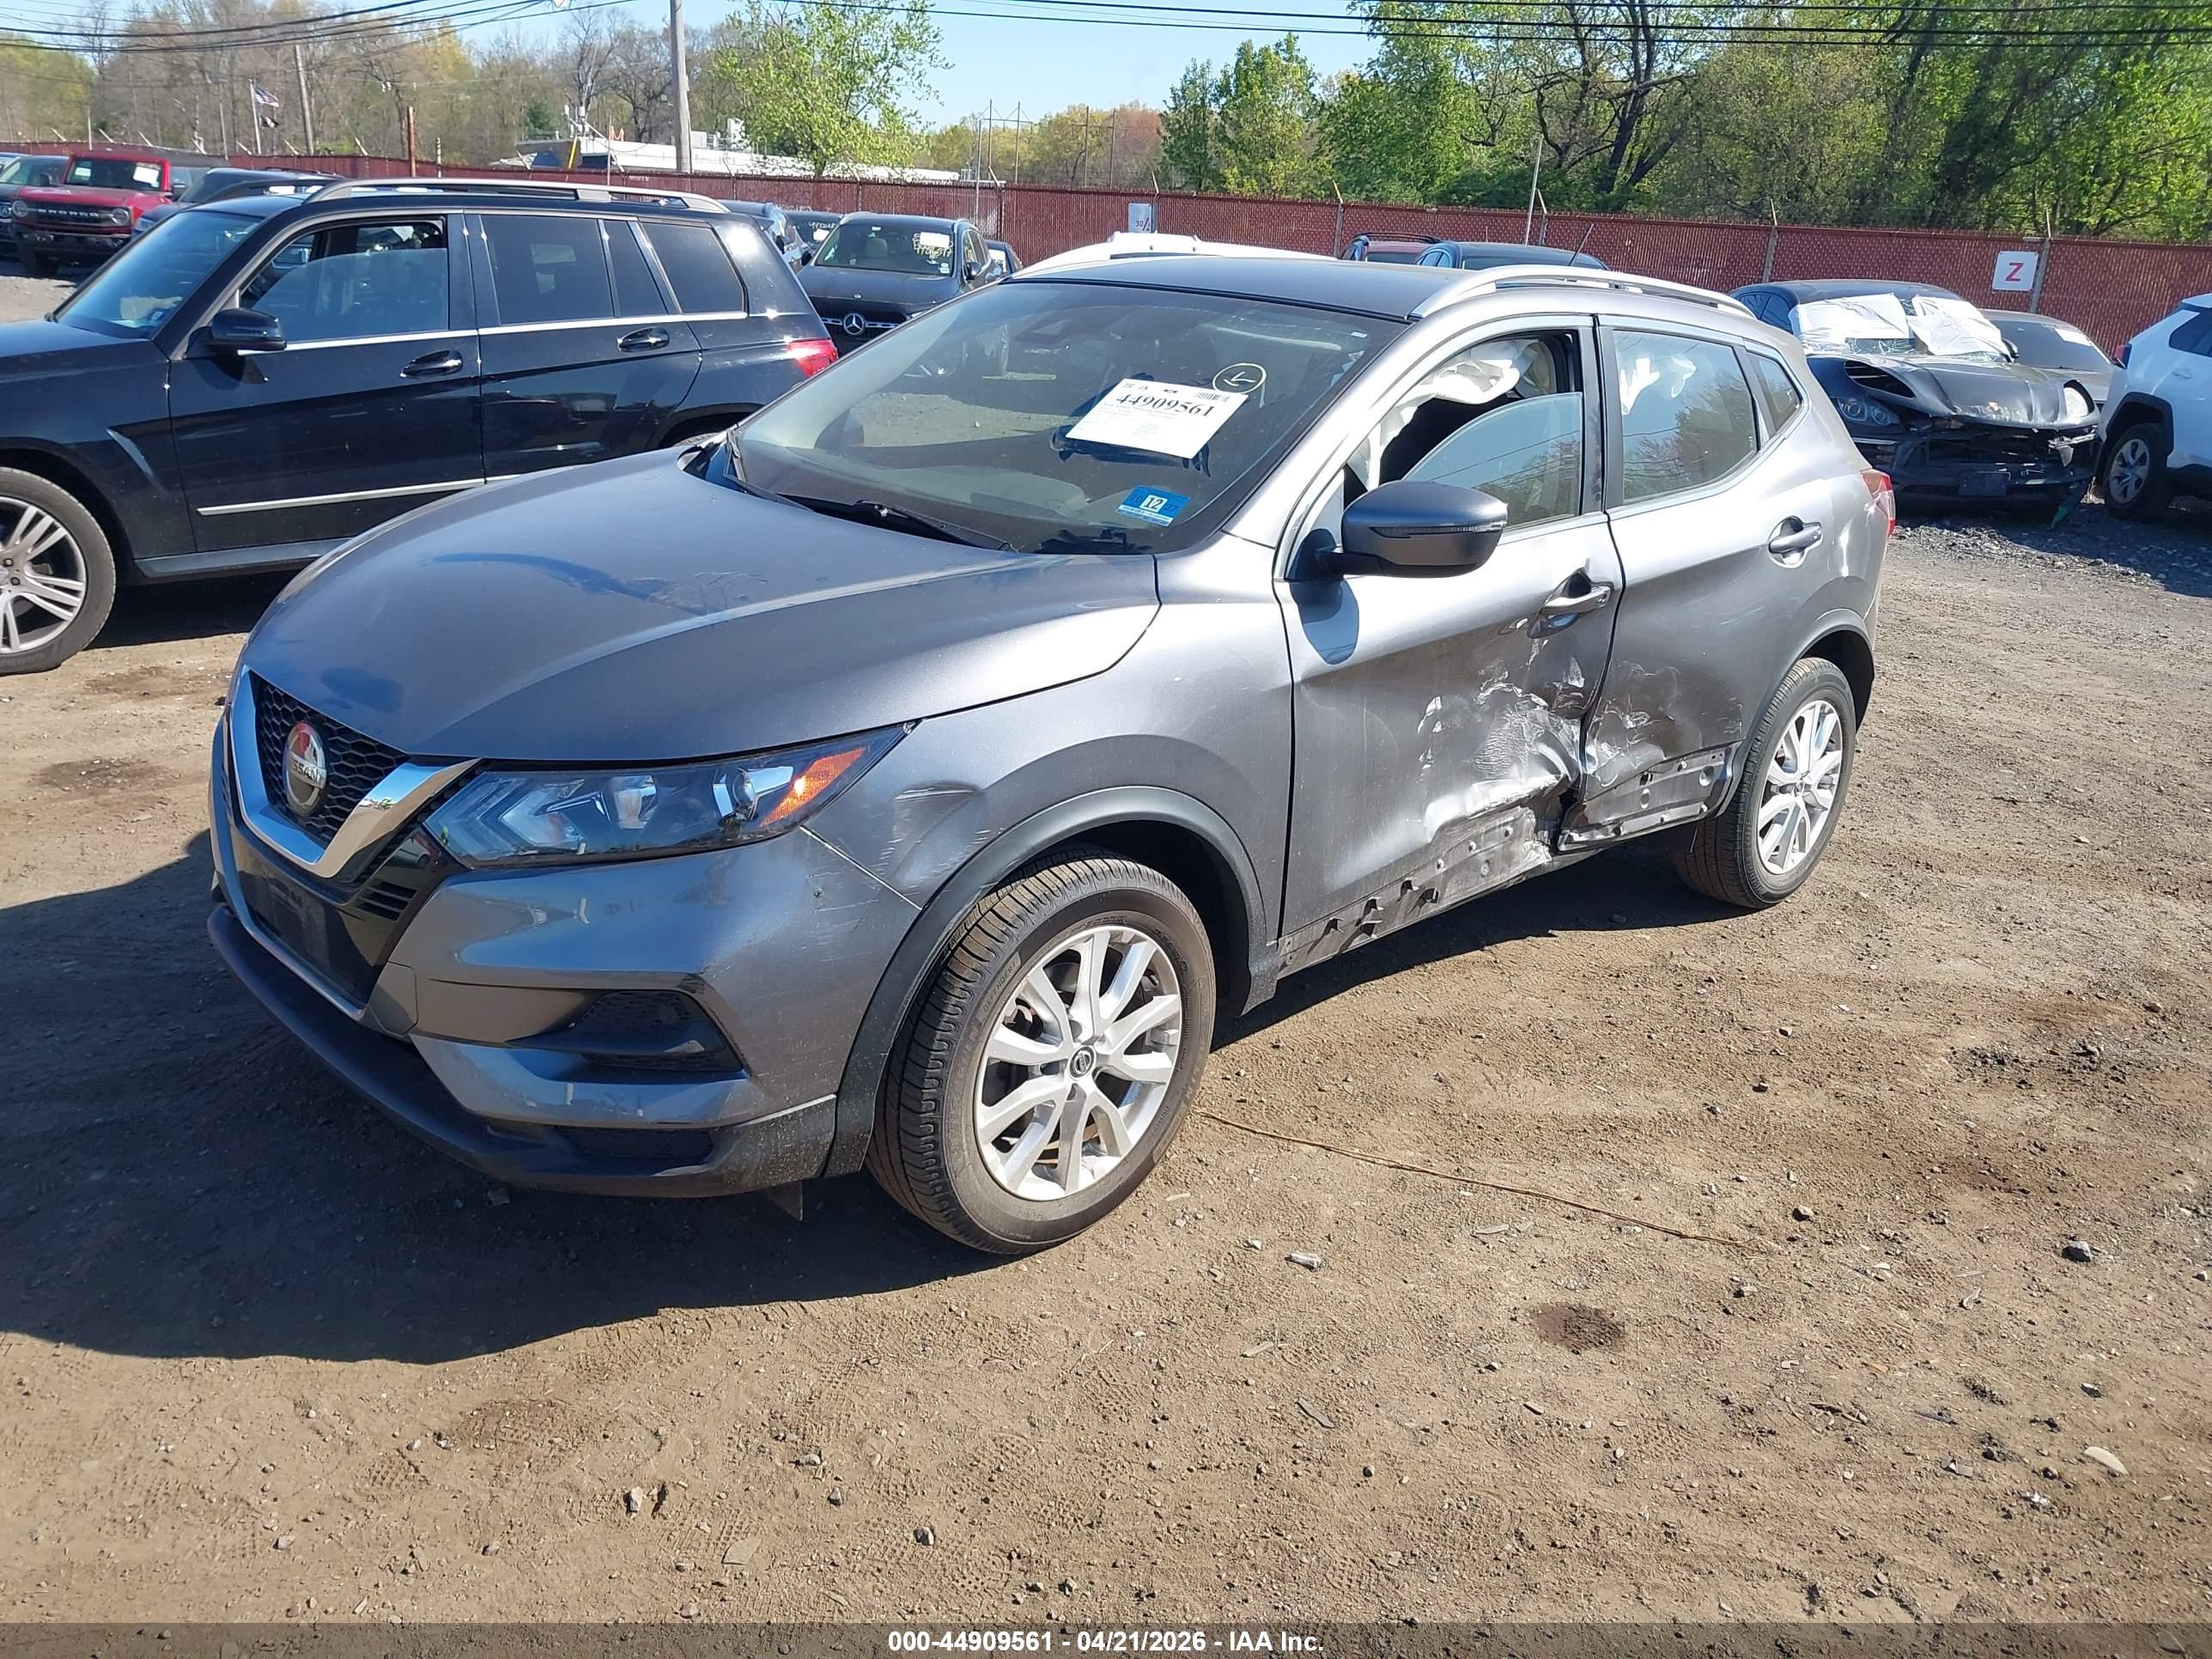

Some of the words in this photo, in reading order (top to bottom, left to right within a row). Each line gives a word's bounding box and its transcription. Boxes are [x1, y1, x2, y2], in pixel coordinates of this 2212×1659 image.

[2005, 261, 2024, 282] Z
[1116, 393, 1216, 416] 44909561
[1143, 496, 1164, 510] 12
